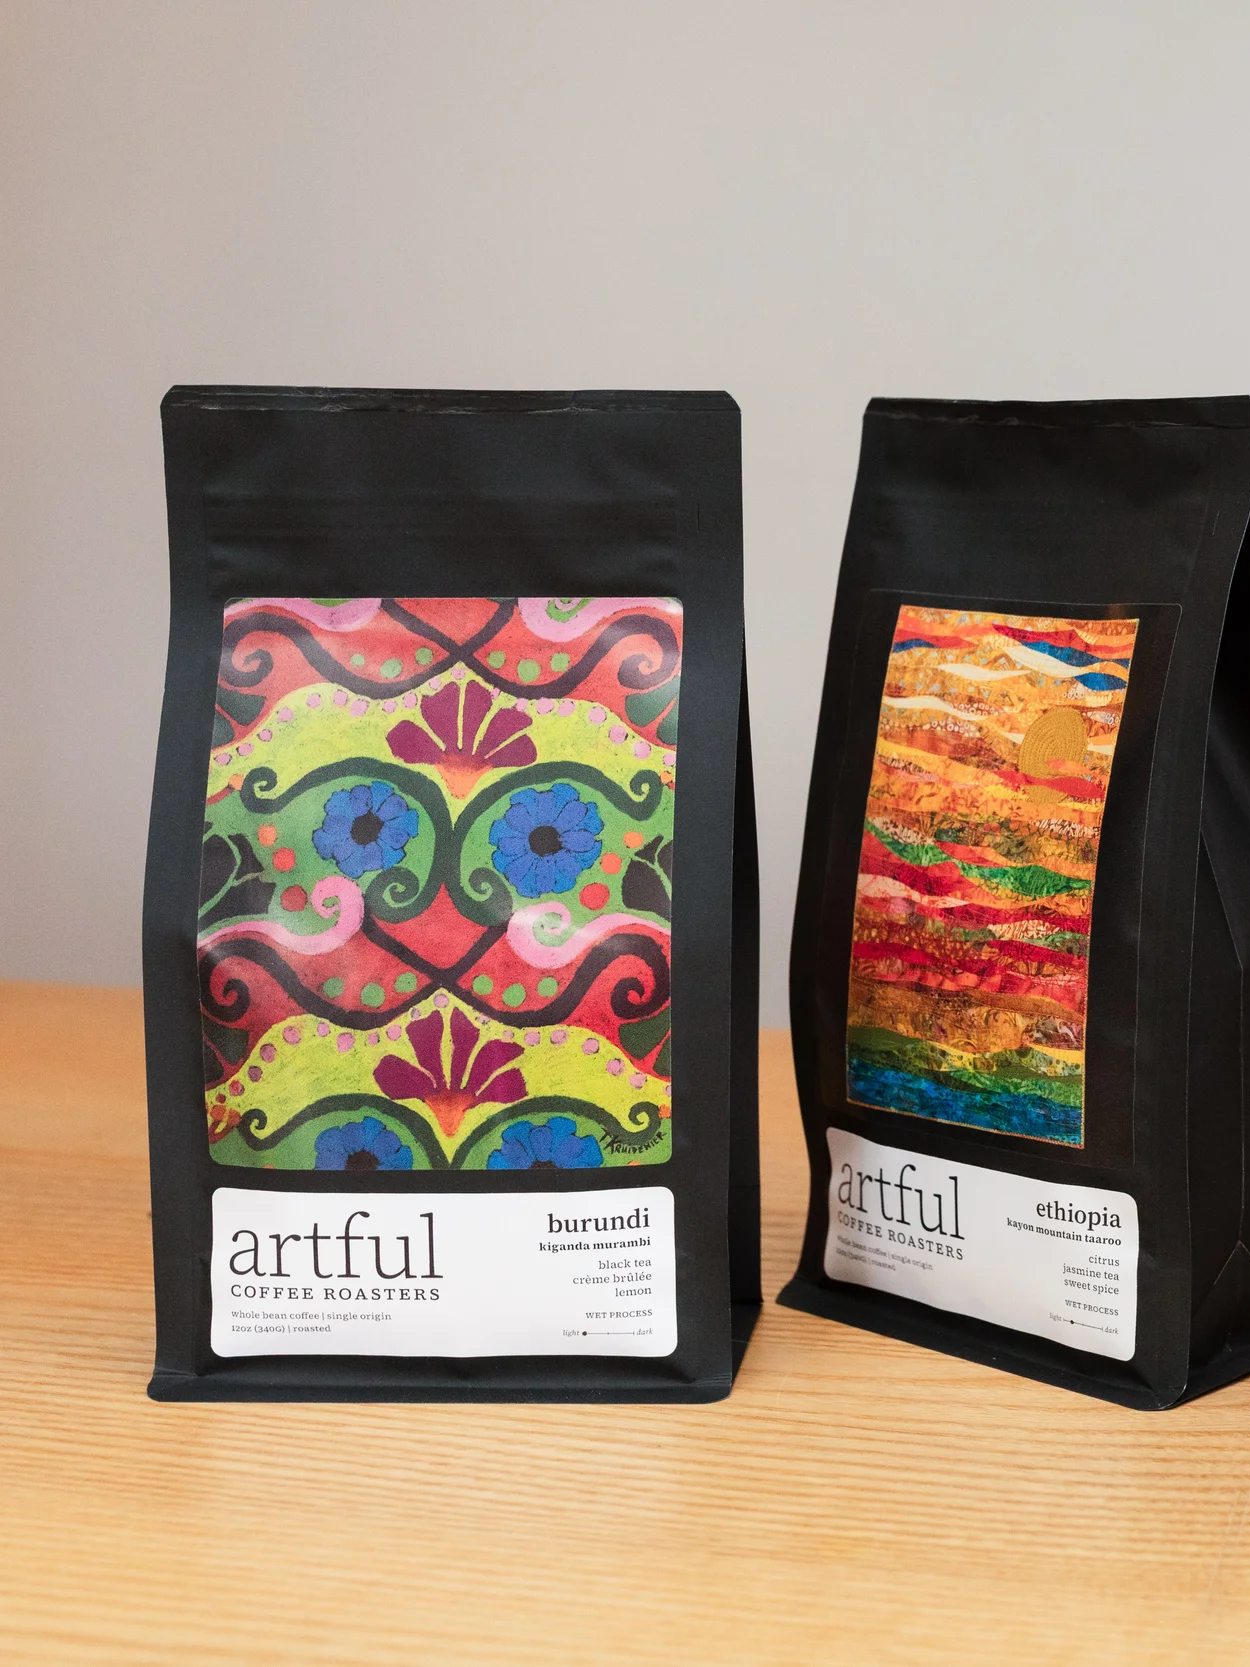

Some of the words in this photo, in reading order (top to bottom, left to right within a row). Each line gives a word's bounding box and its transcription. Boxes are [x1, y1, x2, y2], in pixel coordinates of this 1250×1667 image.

[838, 1163, 965, 1240] artful
[547, 1208, 650, 1233] burundi
[1036, 1201, 1122, 1231] ethiopia
[837, 1211, 882, 1238] COFFEE
[888, 1228, 963, 1261] ROASTERS
[1006, 1217, 1034, 1231] kayon
[1036, 1226, 1082, 1242] mountain
[1085, 1234, 1122, 1246] taaroo
[229, 1211, 443, 1279] artful
[539, 1241, 591, 1253] kiganda
[592, 1237, 651, 1250] murambi
[598, 1259, 631, 1270] black
[634, 1259, 651, 1268] tea
[1088, 1255, 1120, 1267] citrus
[572, 1274, 610, 1285] crème
[613, 1272, 652, 1284] brûlée
[1062, 1263, 1101, 1279] jasmine
[1104, 1272, 1120, 1281] tea
[231, 1285, 314, 1300] COFFEE
[324, 1288, 440, 1301] ROASTERS
[615, 1287, 652, 1297] lemon
[1064, 1278, 1091, 1291] sweet
[1093, 1284, 1120, 1295] spice
[585, 1311, 607, 1319] WET
[609, 1309, 653, 1319] PROCESS
[1065, 1299, 1082, 1309] WET
[1083, 1304, 1119, 1316] PROCESS
[231, 1310, 260, 1320] whole
[262, 1311, 287, 1320] bean
[289, 1311, 319, 1320] coffee
[327, 1312, 358, 1322] single
[360, 1312, 392, 1322] origin
[293, 1324, 331, 1333] roasted
[562, 1329, 580, 1337] light
[636, 1328, 653, 1336] dark
